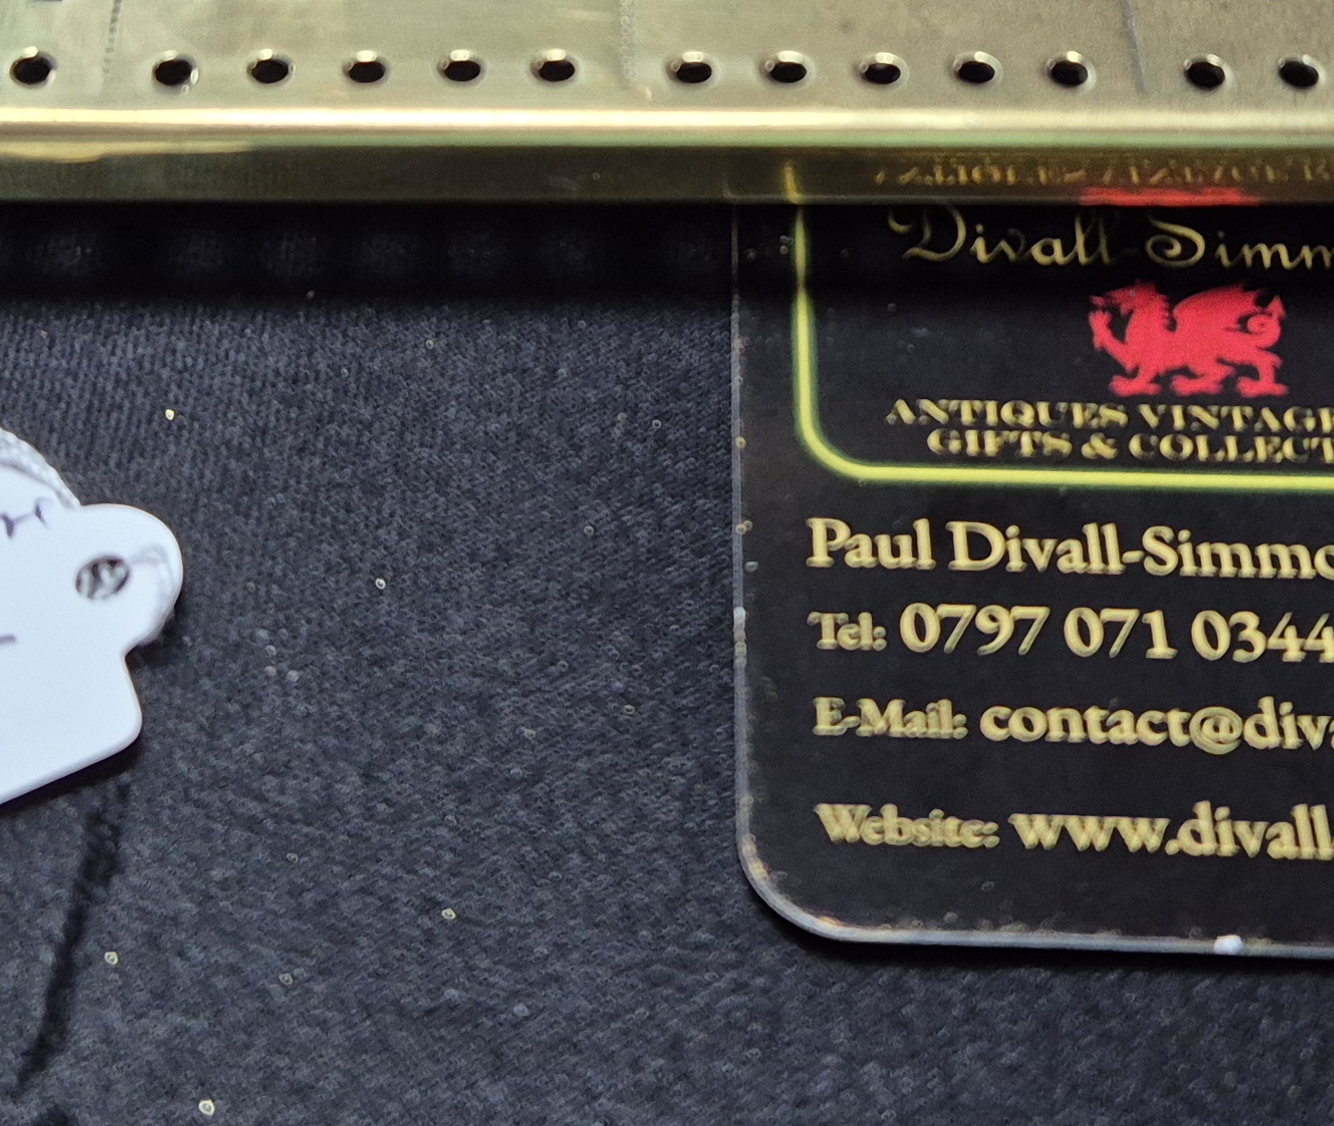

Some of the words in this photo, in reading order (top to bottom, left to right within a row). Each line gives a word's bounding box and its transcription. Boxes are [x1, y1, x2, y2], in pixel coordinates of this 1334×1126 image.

[884, 397, 1130, 430] ANTIQUES
[926, 431, 1073, 460] GIFTS
[1080, 433, 1121, 461] &
[806, 518, 937, 571] Paul
[807, 612, 887, 656] Tel:
[897, 603, 1049, 657] 0797
[1063, 607, 1178, 659] 071
[812, 698, 969, 740] E-Mail:
[814, 802, 1000, 850] Website:
